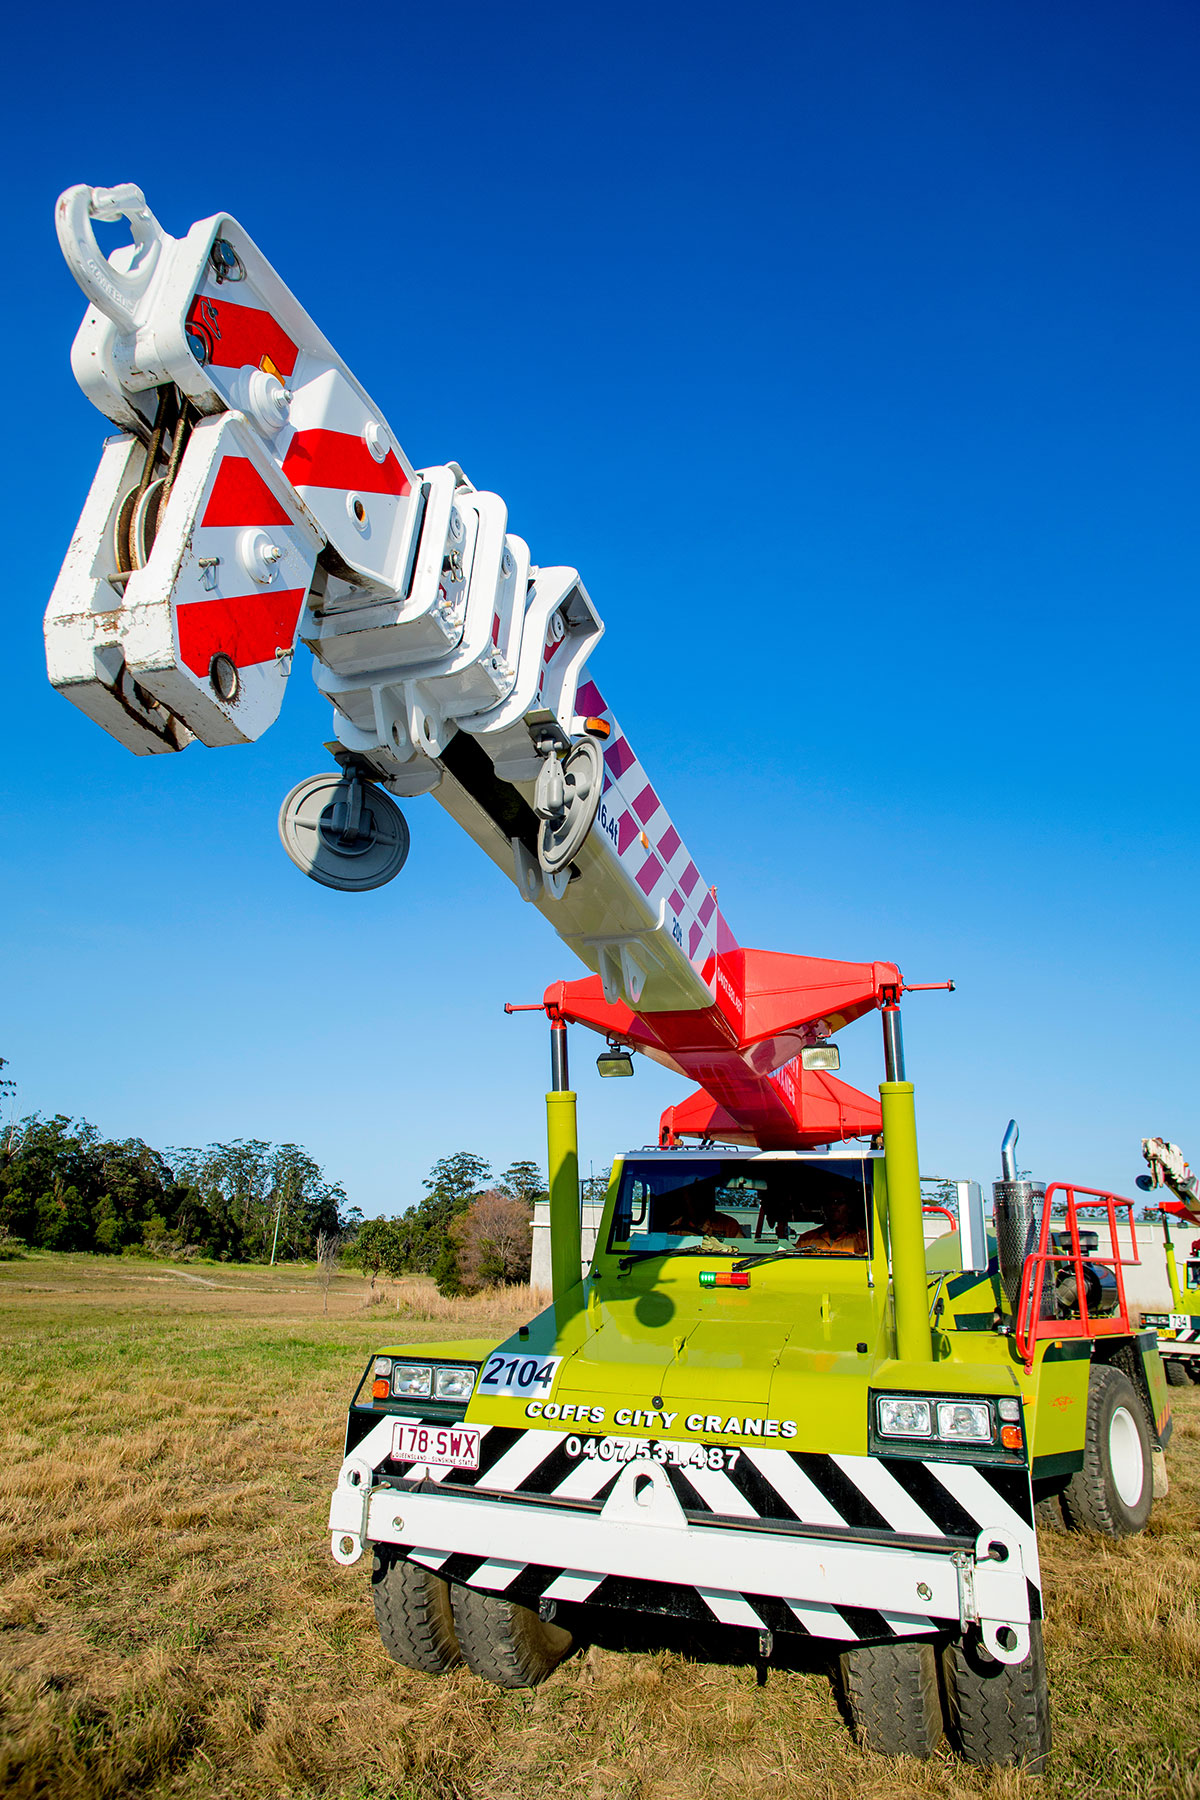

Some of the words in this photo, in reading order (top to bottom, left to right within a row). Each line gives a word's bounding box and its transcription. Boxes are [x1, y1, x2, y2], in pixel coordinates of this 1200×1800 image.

[672, 917, 682, 947] 20t
[1172, 1315, 1187, 1328] 734
[481, 1358, 555, 1388] 2104
[525, 1401, 606, 1423] COFFS
[614, 1408, 678, 1430] CITY
[685, 1414, 798, 1438] CRANES
[394, 1452, 427, 1461] QUEENSLAND
[431, 1456, 456, 1465] SUNSHINE
[458, 1459, 474, 1467] STATE
[565, 1436, 741, 1471] 0407.531.487
